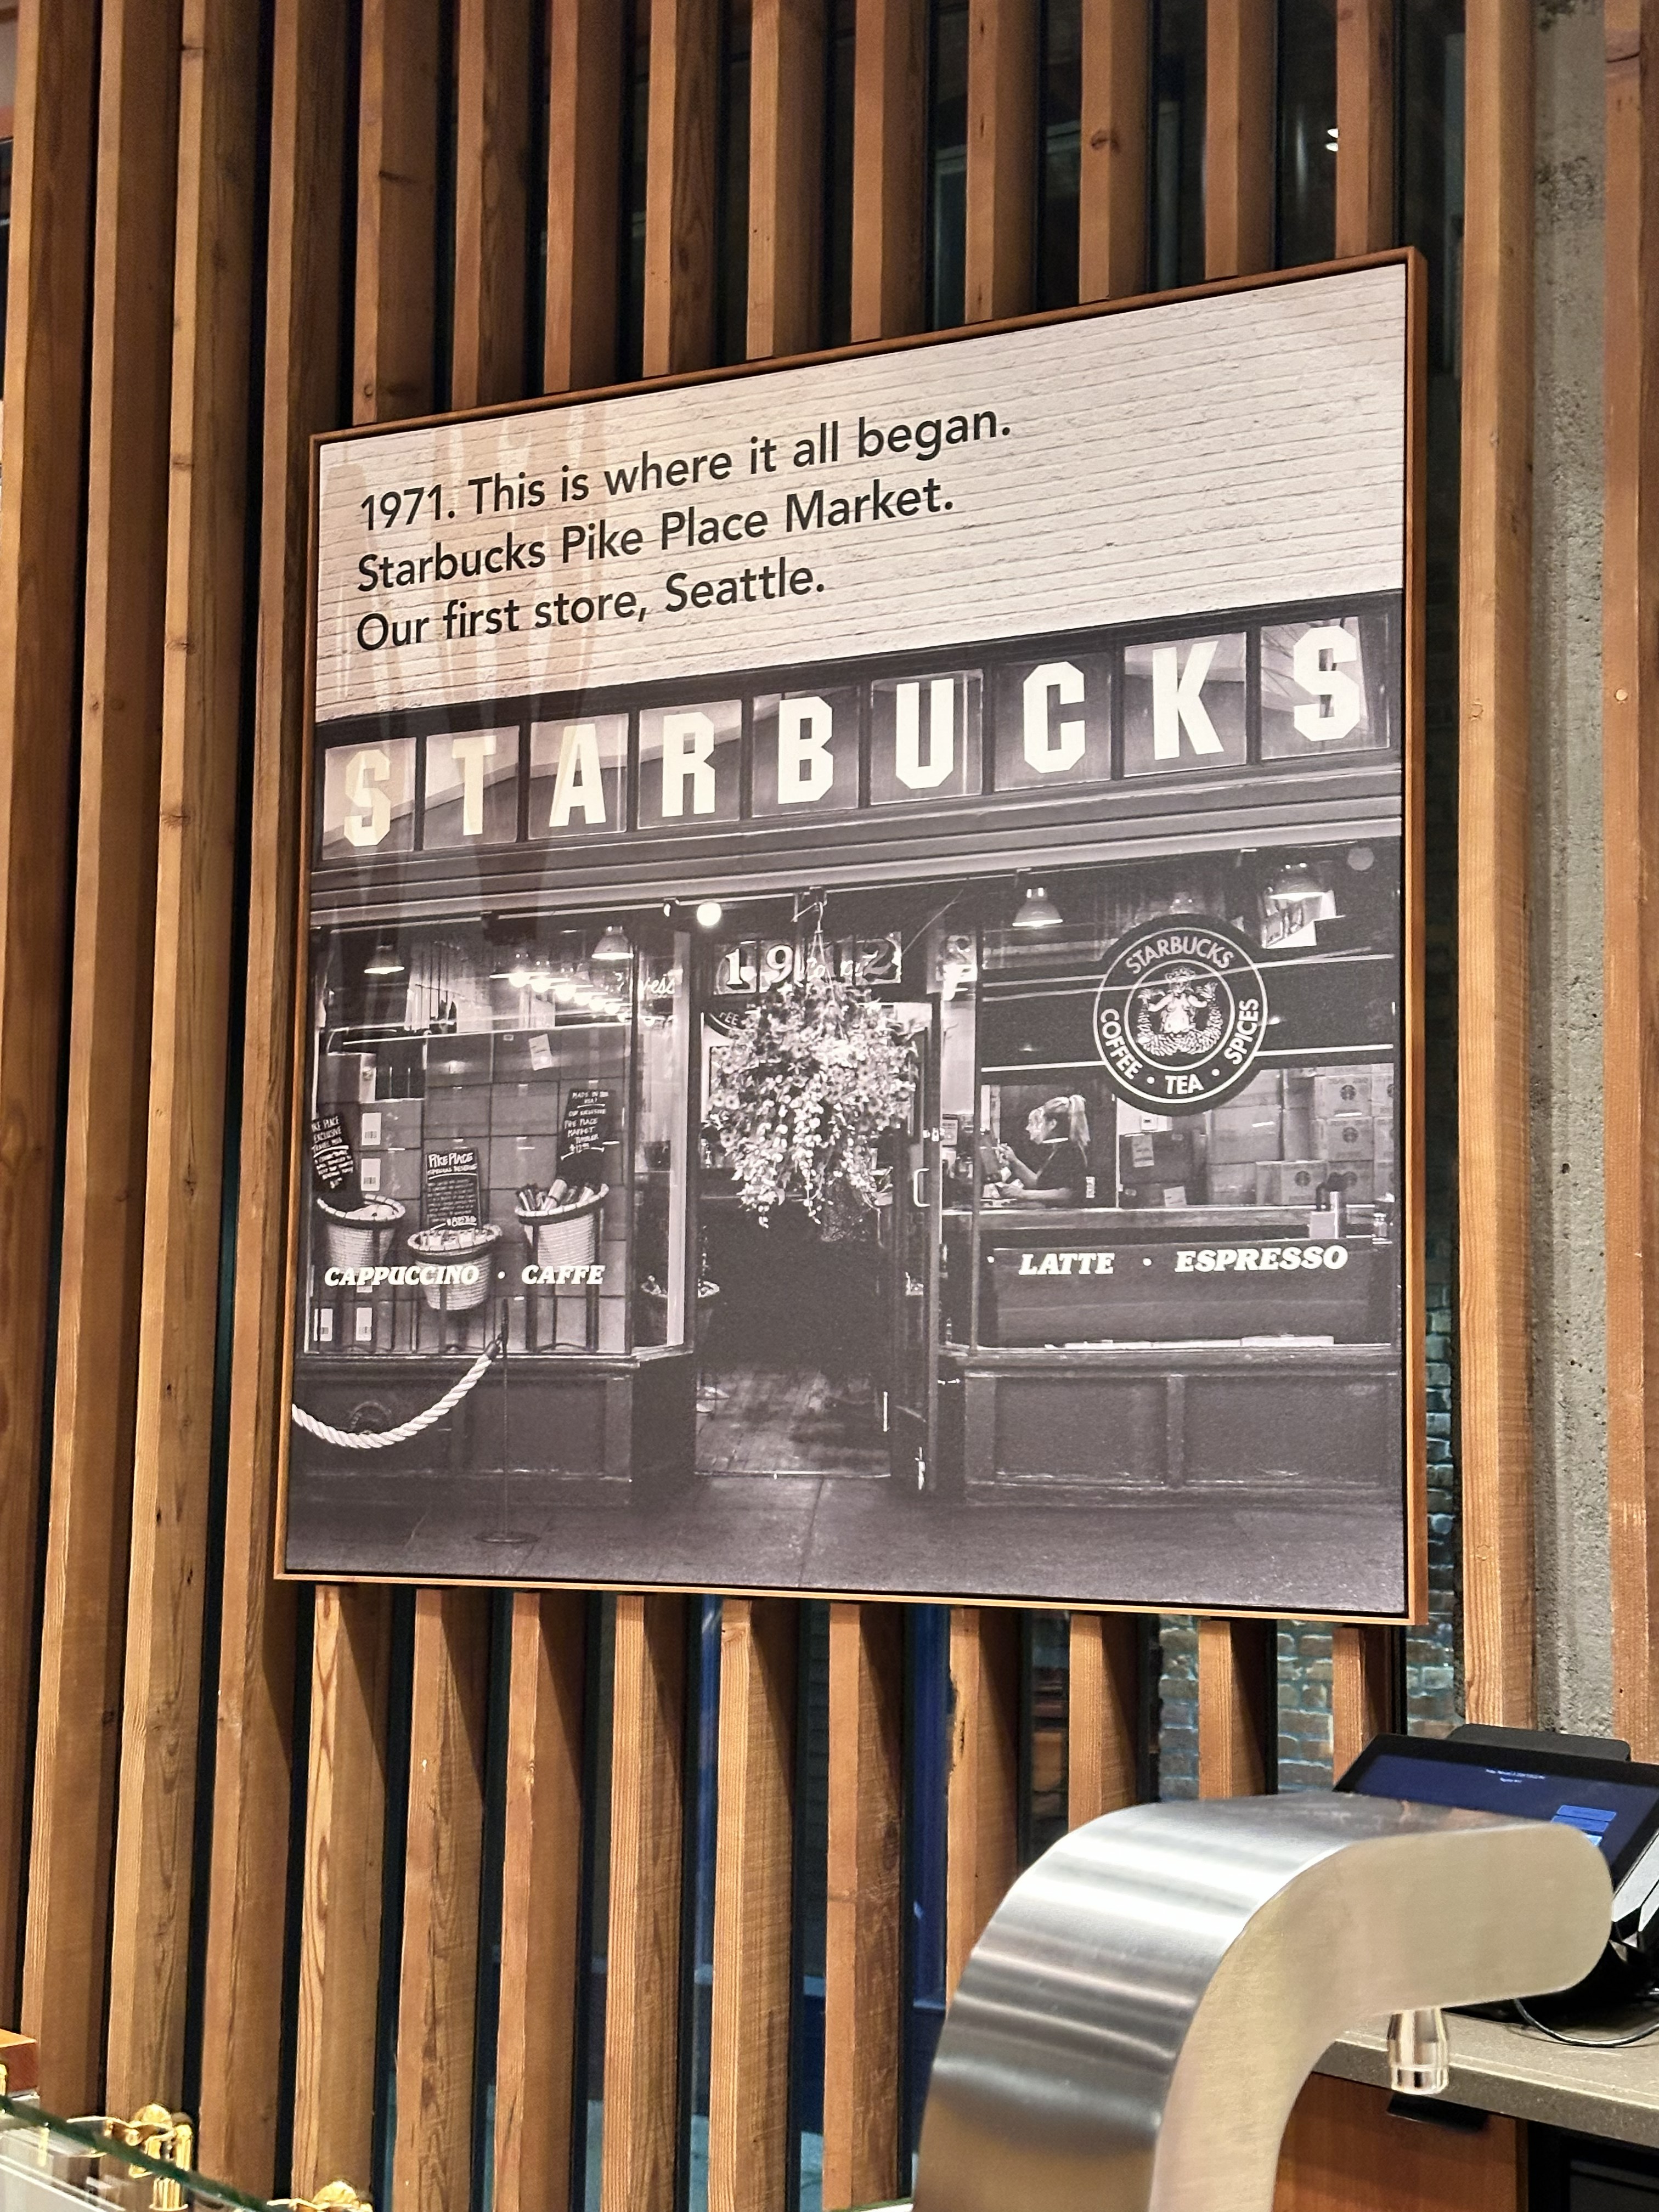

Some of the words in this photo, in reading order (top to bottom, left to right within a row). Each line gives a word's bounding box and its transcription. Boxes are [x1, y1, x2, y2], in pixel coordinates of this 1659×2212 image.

[361, 484, 455, 531] 1971.
[467, 471, 545, 515] This
[562, 465, 589, 502] is
[604, 451, 732, 495] where
[751, 436, 776, 475] it
[793, 421, 838, 468] all
[859, 411, 1010, 461] began.
[357, 532, 545, 592] Starbucks
[562, 519, 643, 563] Pike
[662, 506, 768, 550] Place
[786, 478, 953, 532] Market.
[357, 613, 430, 651] Our
[443, 599, 521, 640] first
[534, 591, 646, 628] store,
[665, 556, 824, 612] Seattle.
[343, 625, 1361, 847] STARBUCKS
[1126, 936, 1234, 974] STARBUCKS
[1100, 1008, 1143, 1080] COFFEE
[1223, 998, 1259, 1065] SPICES
[1165, 1074, 1204, 1094] TEA
[428, 1154, 448, 1168] PIKE
[448, 1152, 473, 1166] PLACE
[324, 1265, 479, 1286] CAPPUCCINO
[521, 1265, 605, 1284] CAFFE
[1018, 1252, 1115, 1276] LATTE
[1174, 1245, 1348, 1272] ESPRESSO
